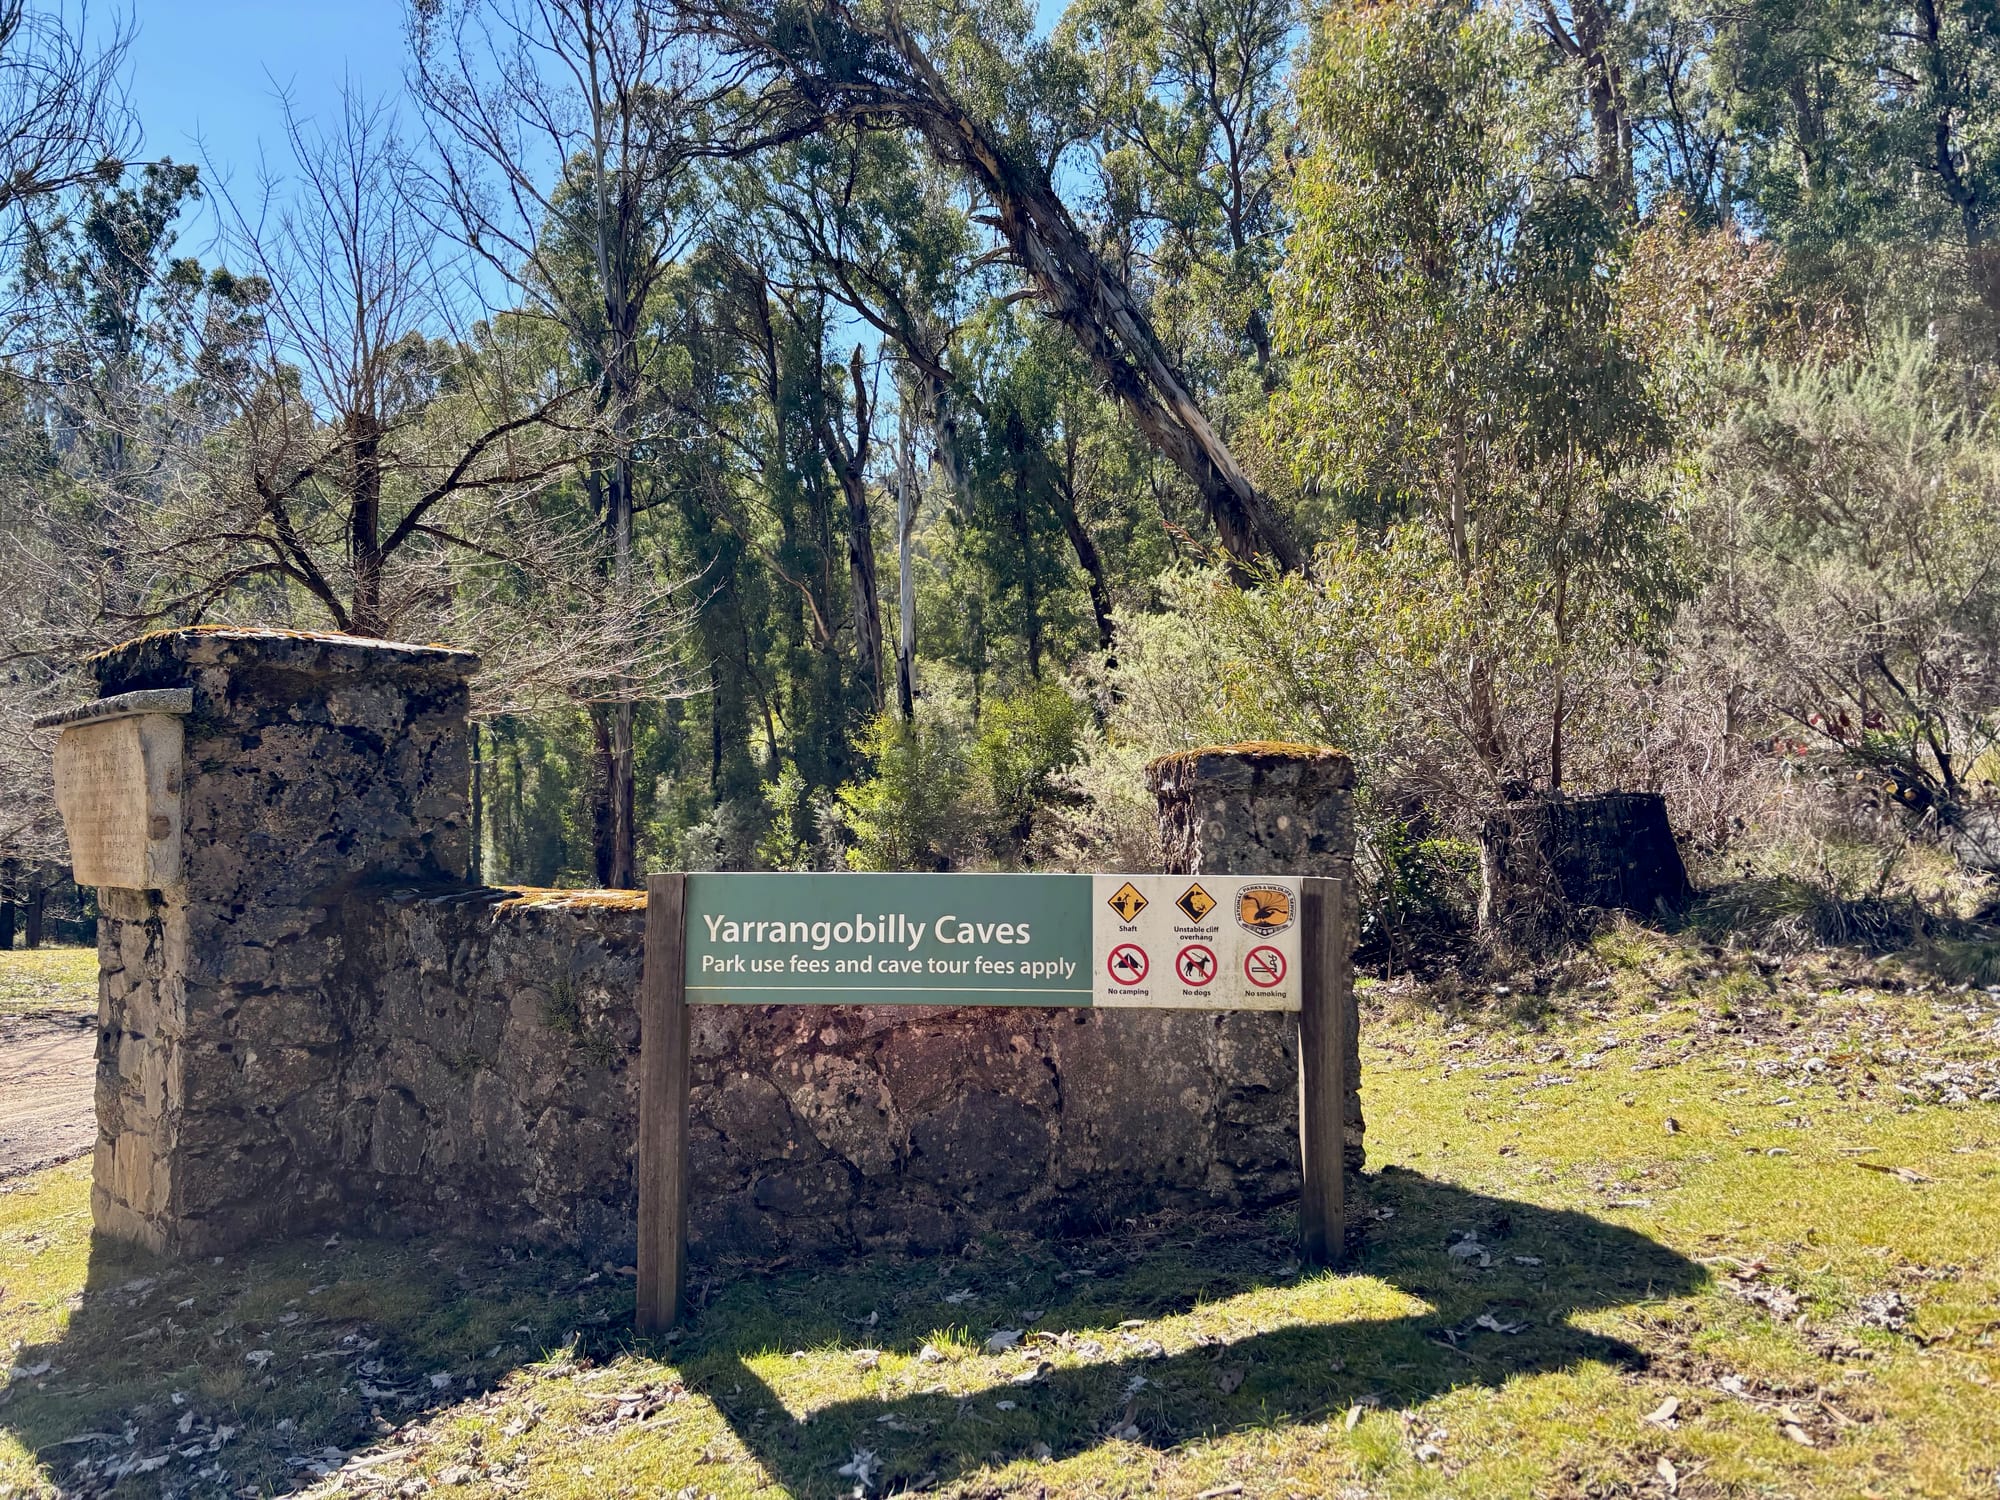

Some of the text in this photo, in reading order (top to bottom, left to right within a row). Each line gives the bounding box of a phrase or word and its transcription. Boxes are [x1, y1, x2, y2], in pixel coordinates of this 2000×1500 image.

[703, 913, 1031, 951] Yarrangobilly Caves
[1179, 934, 1213, 942] overhang
[702, 954, 1077, 980] Park use fees and cave tour fees apply
[1119, 988, 1149, 997] camping
[1194, 989, 1211, 997] dogs
[1256, 990, 1287, 999] smoking
